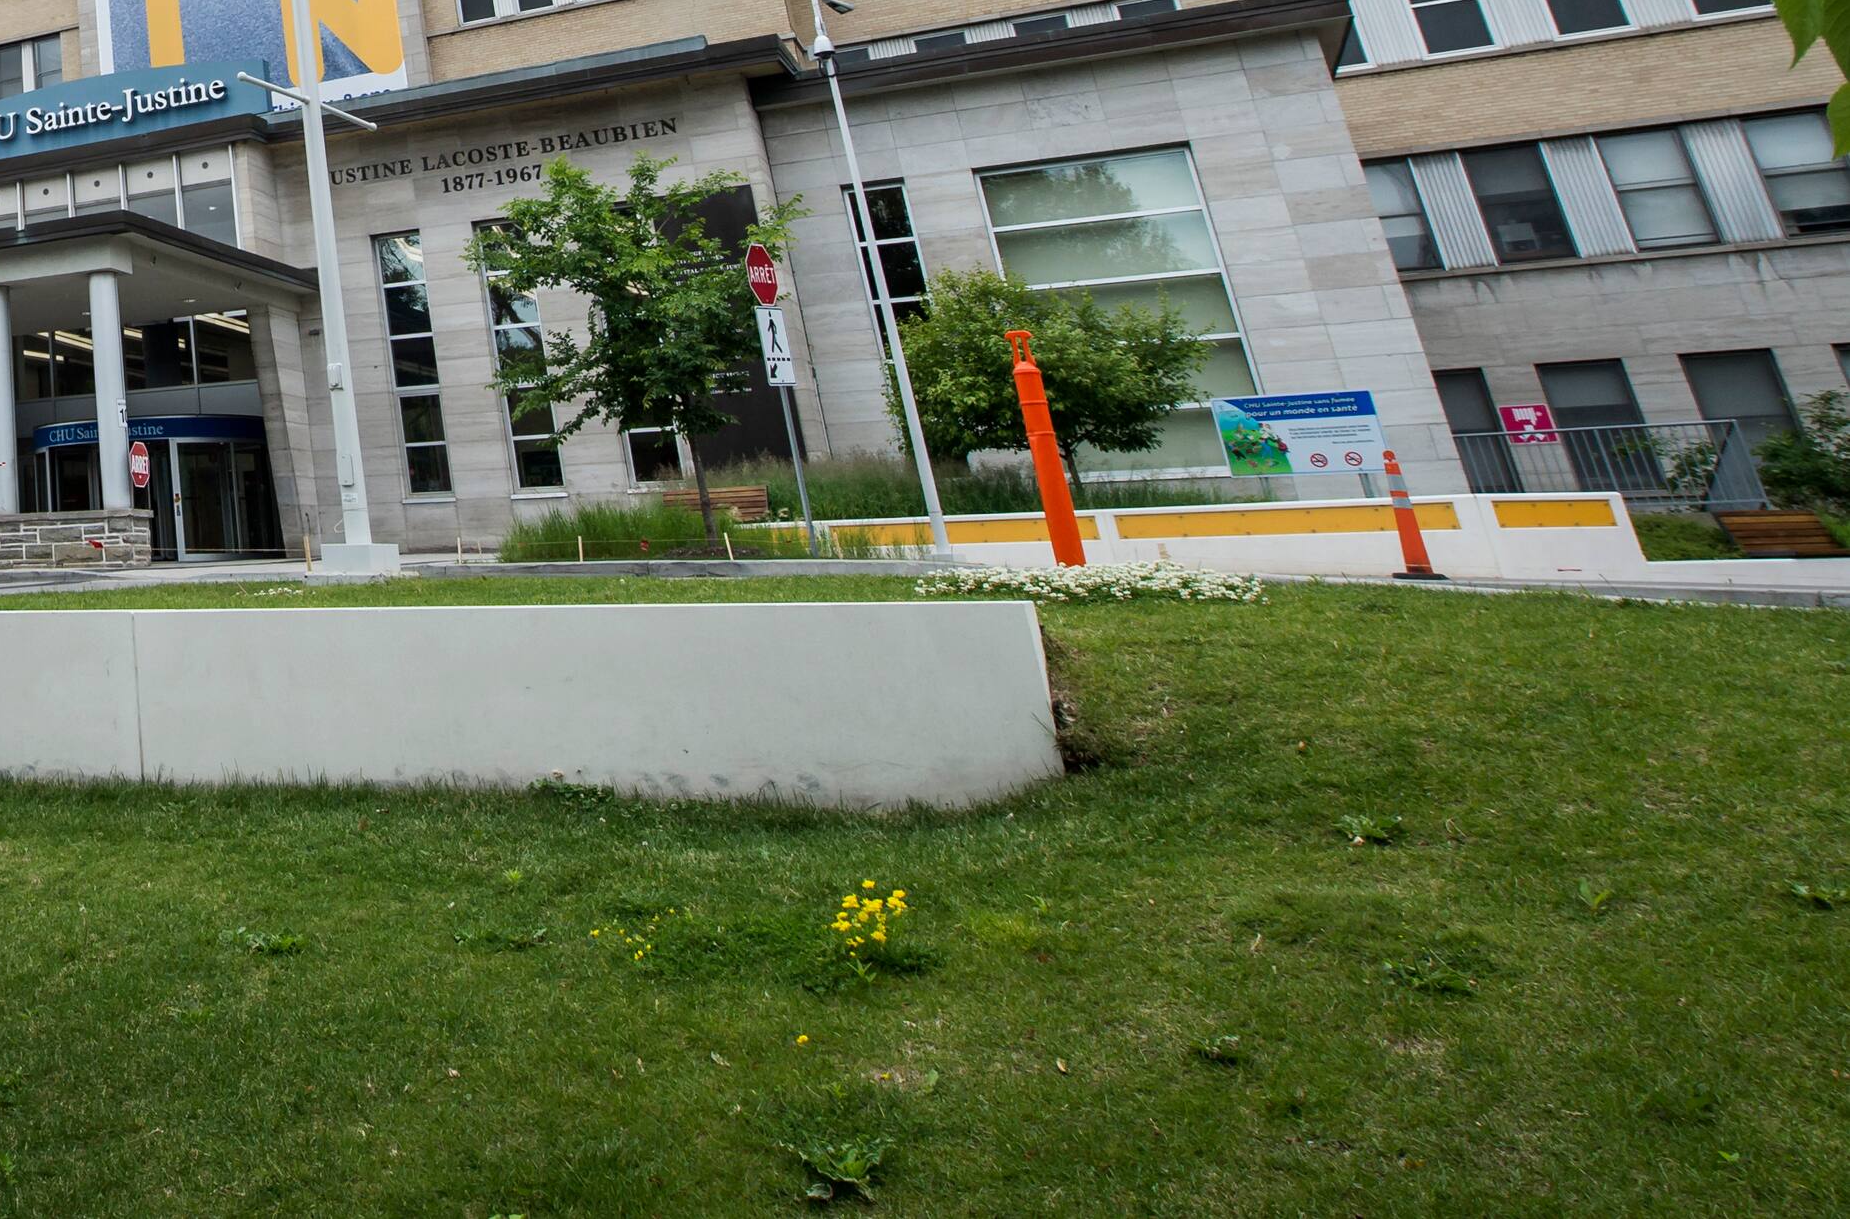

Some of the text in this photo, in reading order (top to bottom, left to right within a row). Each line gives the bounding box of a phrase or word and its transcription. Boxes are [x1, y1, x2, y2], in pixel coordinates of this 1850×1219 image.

[25, 78, 226, 136] Sainte-Justine
[330, 117, 679, 186] USTINE LACOSTE-BEAUBIEN
[441, 164, 543, 195] 1877-1967
[749, 264, 776, 284] ARRÊT
[1245, 410, 1268, 419] pour
[1283, 406, 1316, 416] monde
[49, 427, 75, 443] CHU
